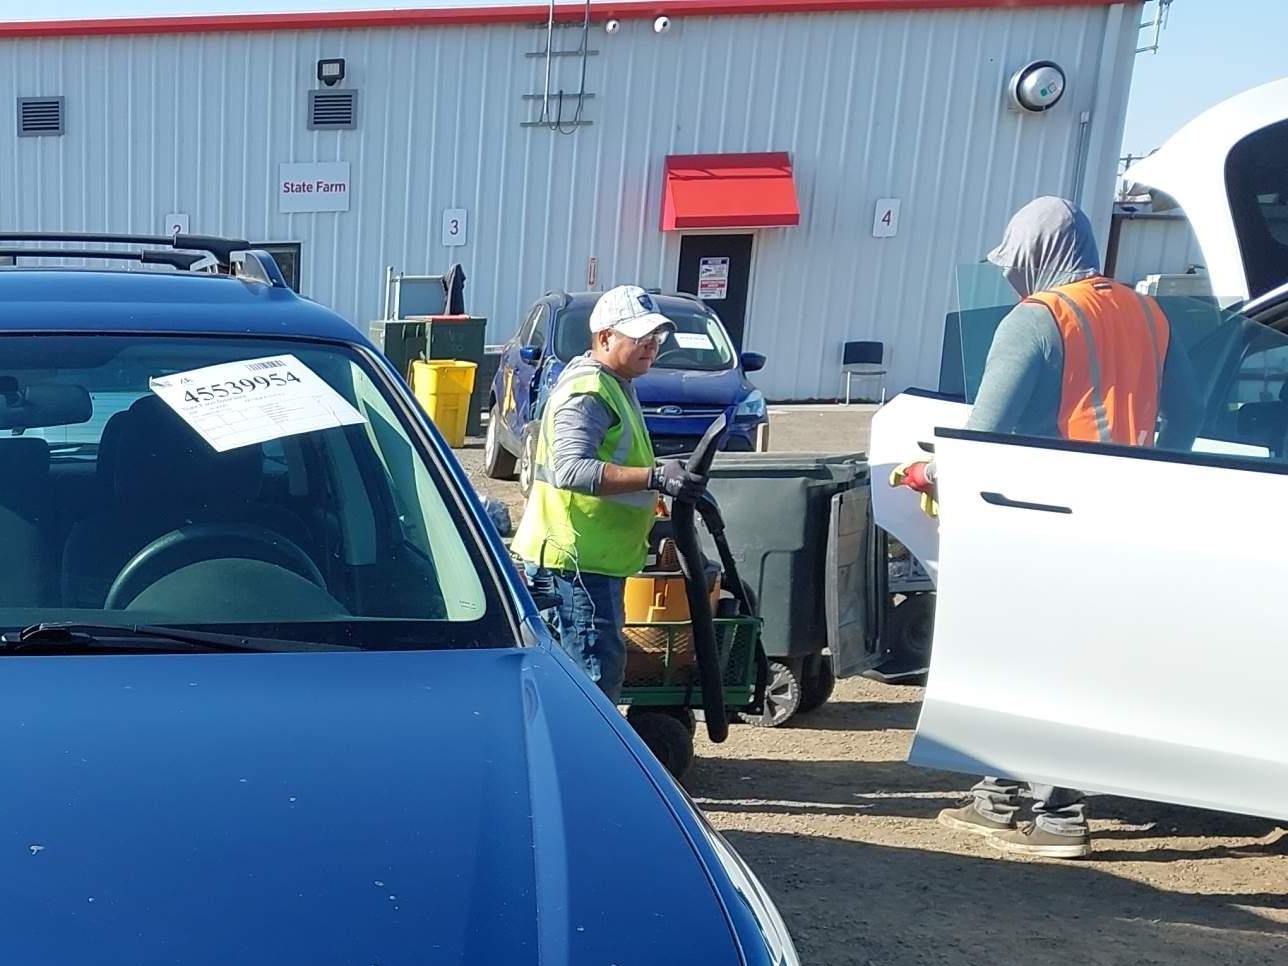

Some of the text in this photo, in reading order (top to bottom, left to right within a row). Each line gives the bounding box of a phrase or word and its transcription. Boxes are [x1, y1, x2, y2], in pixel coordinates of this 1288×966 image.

[283, 181, 346, 193] State Farm
[881, 209, 892, 226] 4
[449, 219, 459, 236] 3
[184, 371, 302, 403] 45539954
